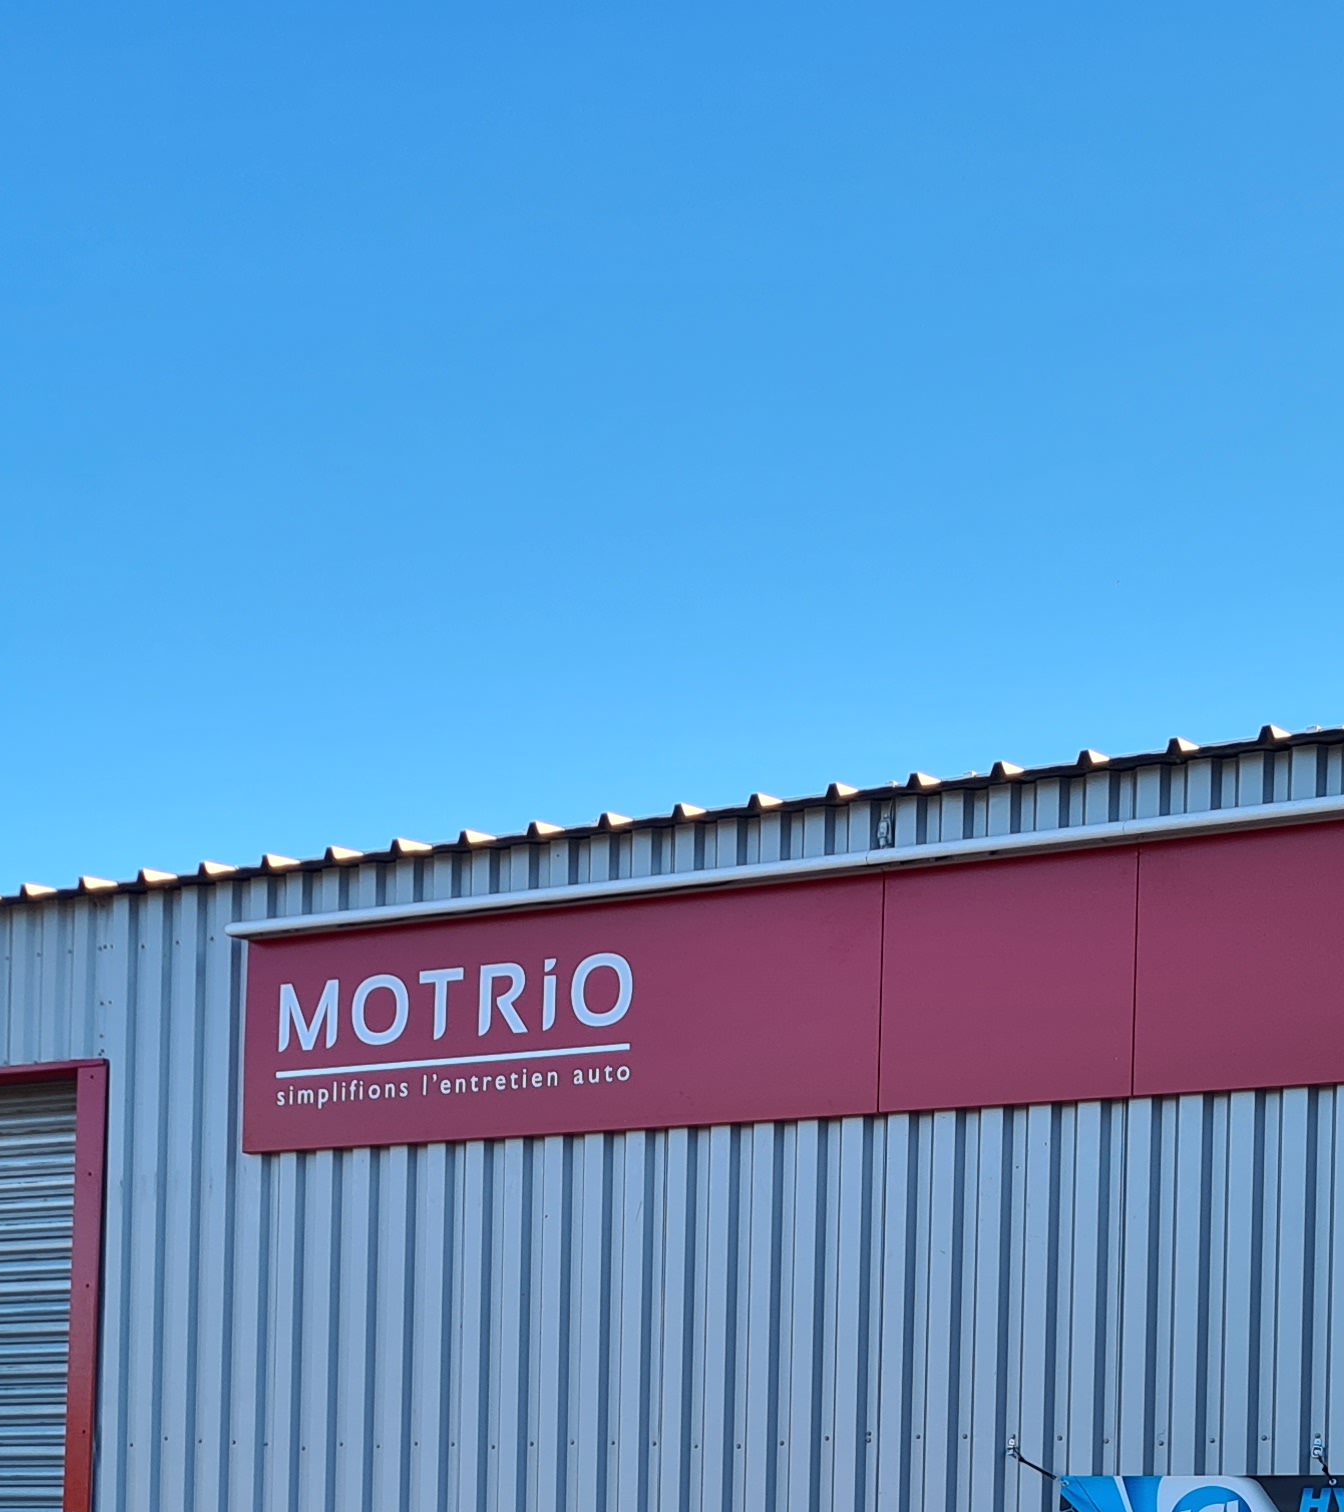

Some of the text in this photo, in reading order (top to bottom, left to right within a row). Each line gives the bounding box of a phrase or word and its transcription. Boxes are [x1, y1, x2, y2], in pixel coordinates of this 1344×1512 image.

[276, 1064, 630, 1108] simplifions l'entretien auto
